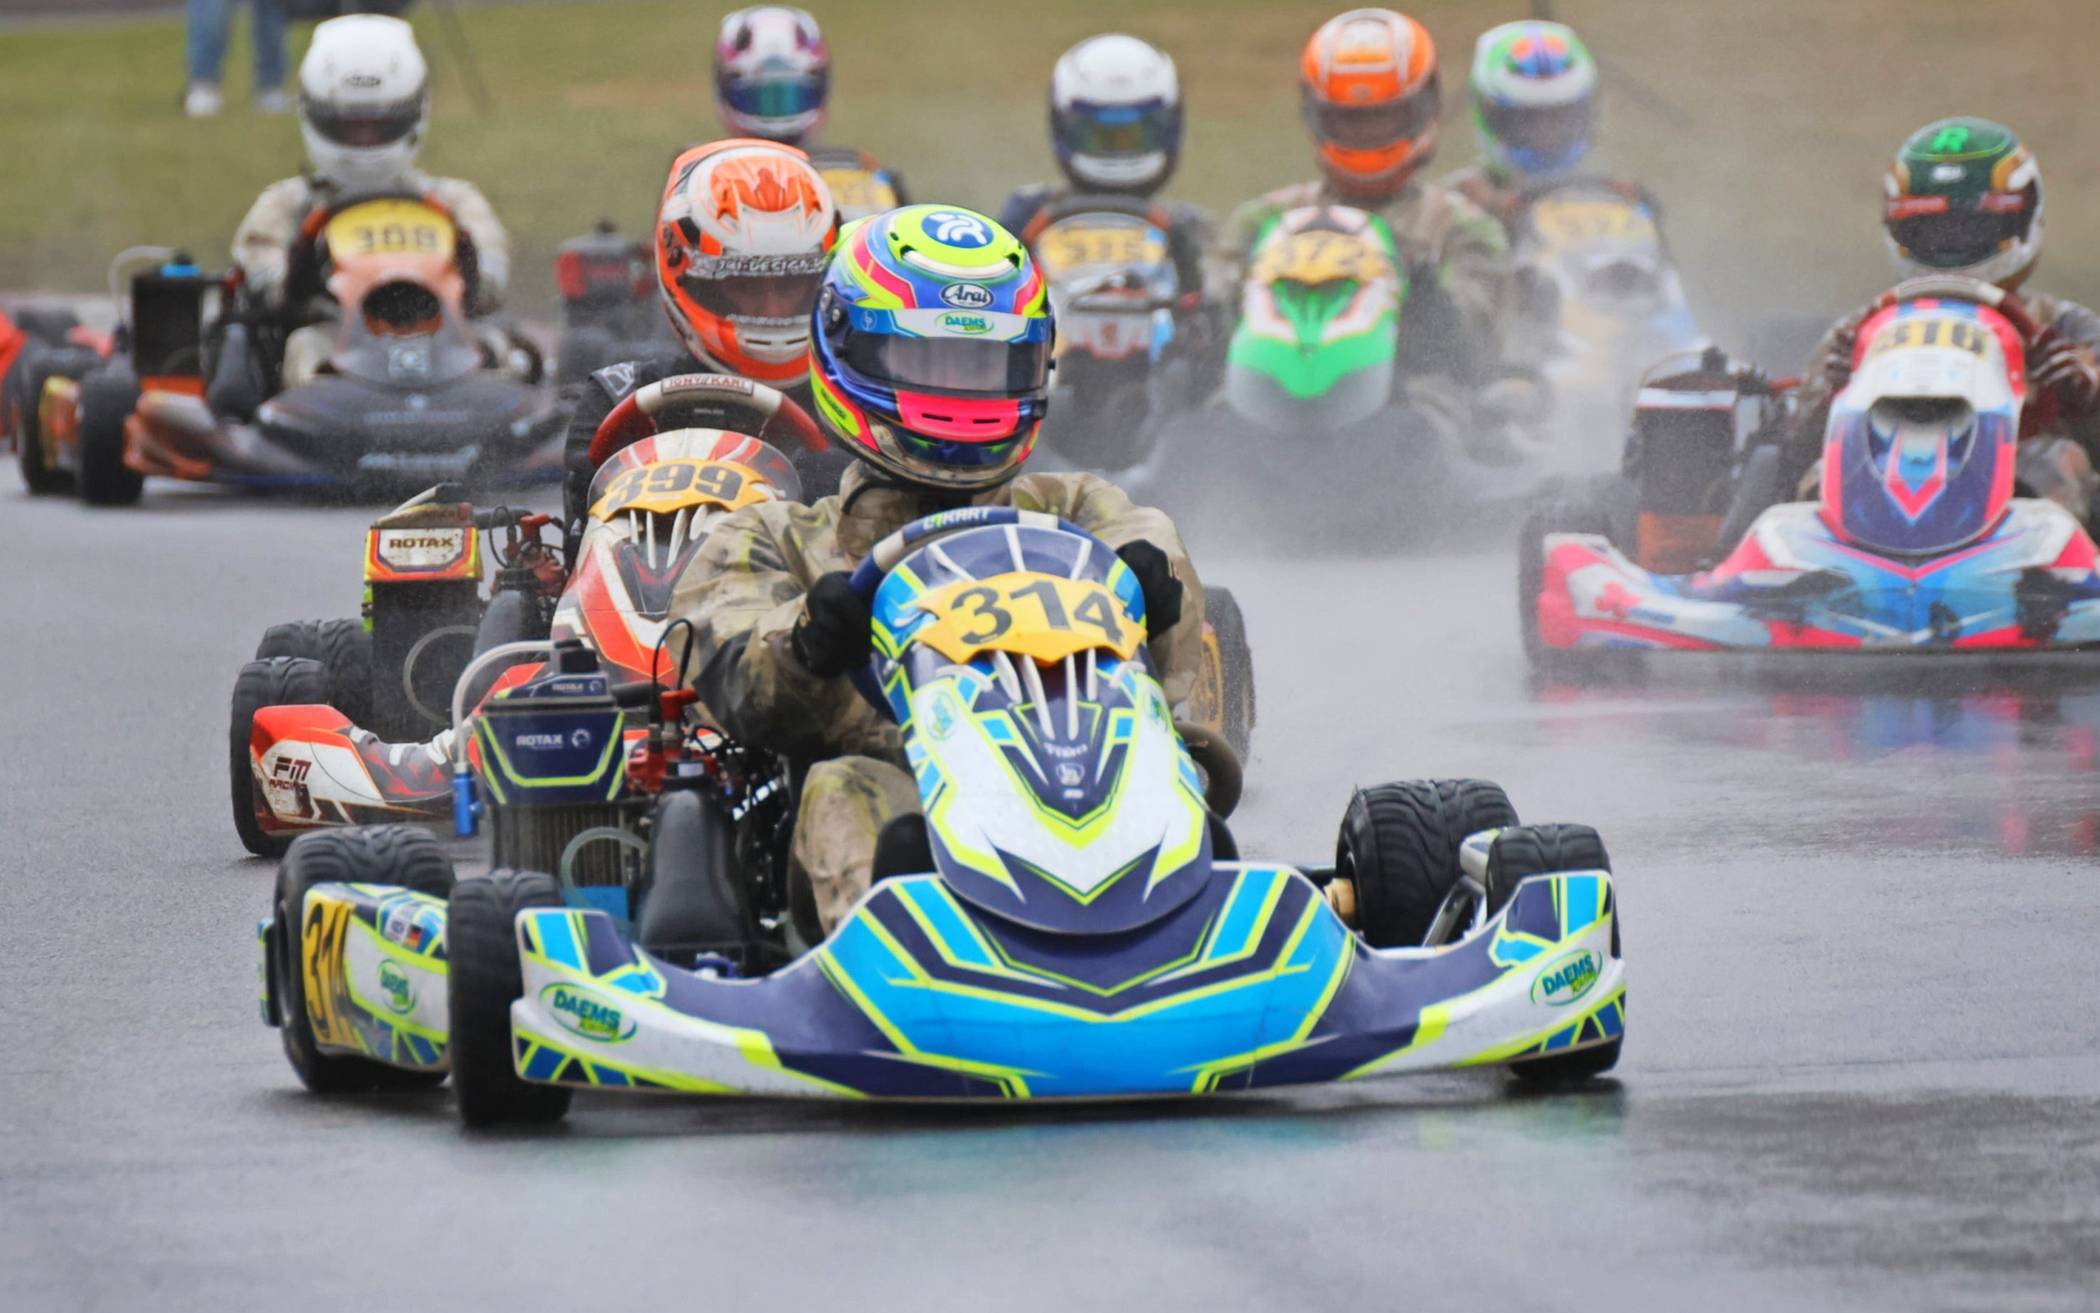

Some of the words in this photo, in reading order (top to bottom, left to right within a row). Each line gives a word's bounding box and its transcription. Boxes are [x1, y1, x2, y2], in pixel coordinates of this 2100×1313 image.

[1931, 126, 1970, 153] R
[944, 285, 988, 304] Arai
[944, 315, 986, 329] DAEMS
[606, 463, 742, 512] 399
[389, 537, 454, 549] ROTAX
[951, 580, 1124, 645] 314
[516, 734, 563, 746] ROTAX
[1541, 953, 1595, 997] DAEMS
[553, 989, 621, 1032] DAEMS
